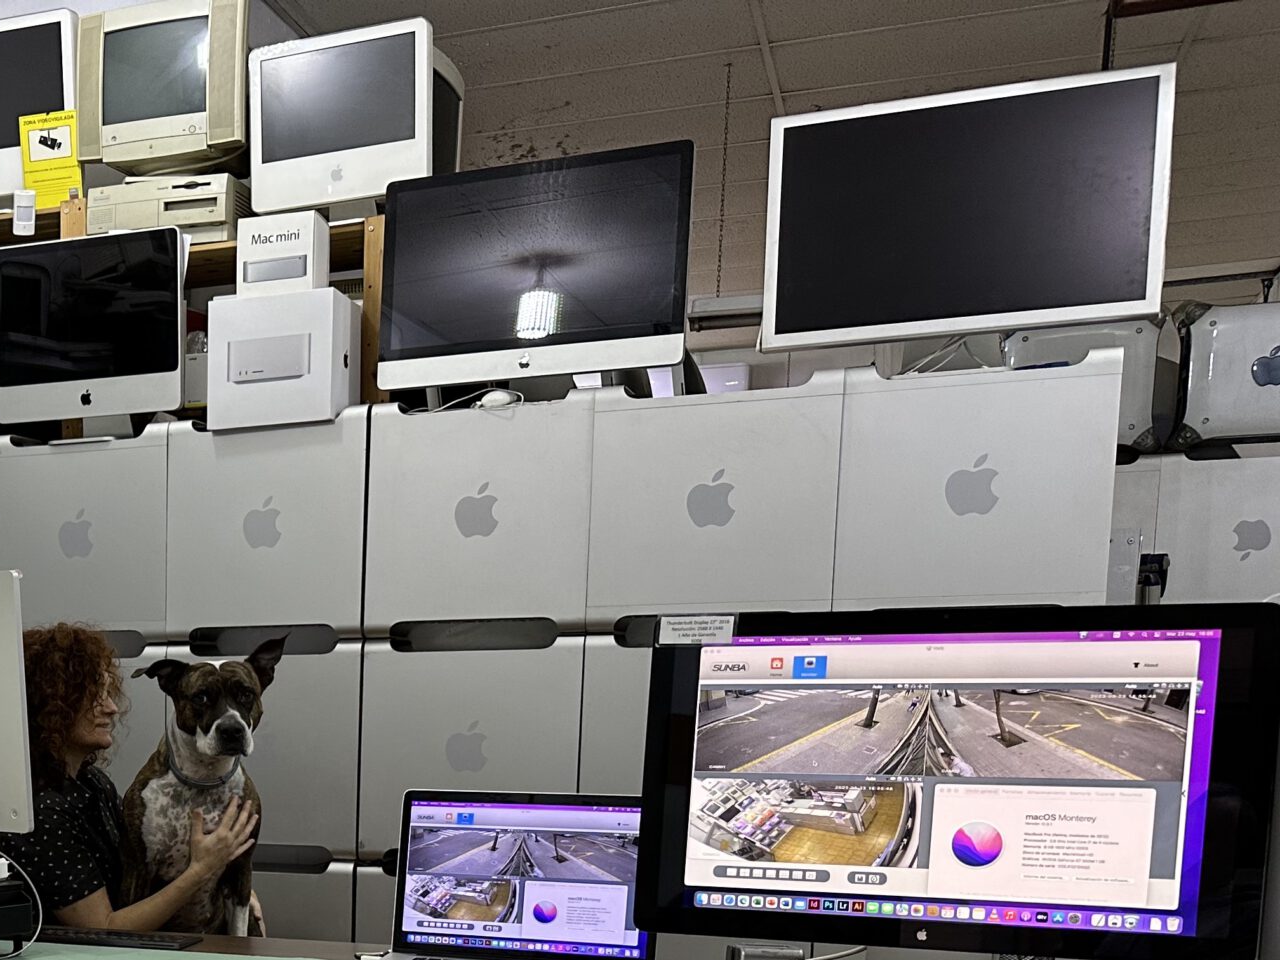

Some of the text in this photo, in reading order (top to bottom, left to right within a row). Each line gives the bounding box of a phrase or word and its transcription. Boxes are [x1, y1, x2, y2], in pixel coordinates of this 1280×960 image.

[23, 118, 36, 126] ZONA
[251, 229, 300, 245] Mac mini
[712, 664, 746, 672] SUNBA
[1058, 814, 1097, 823] Monterey
